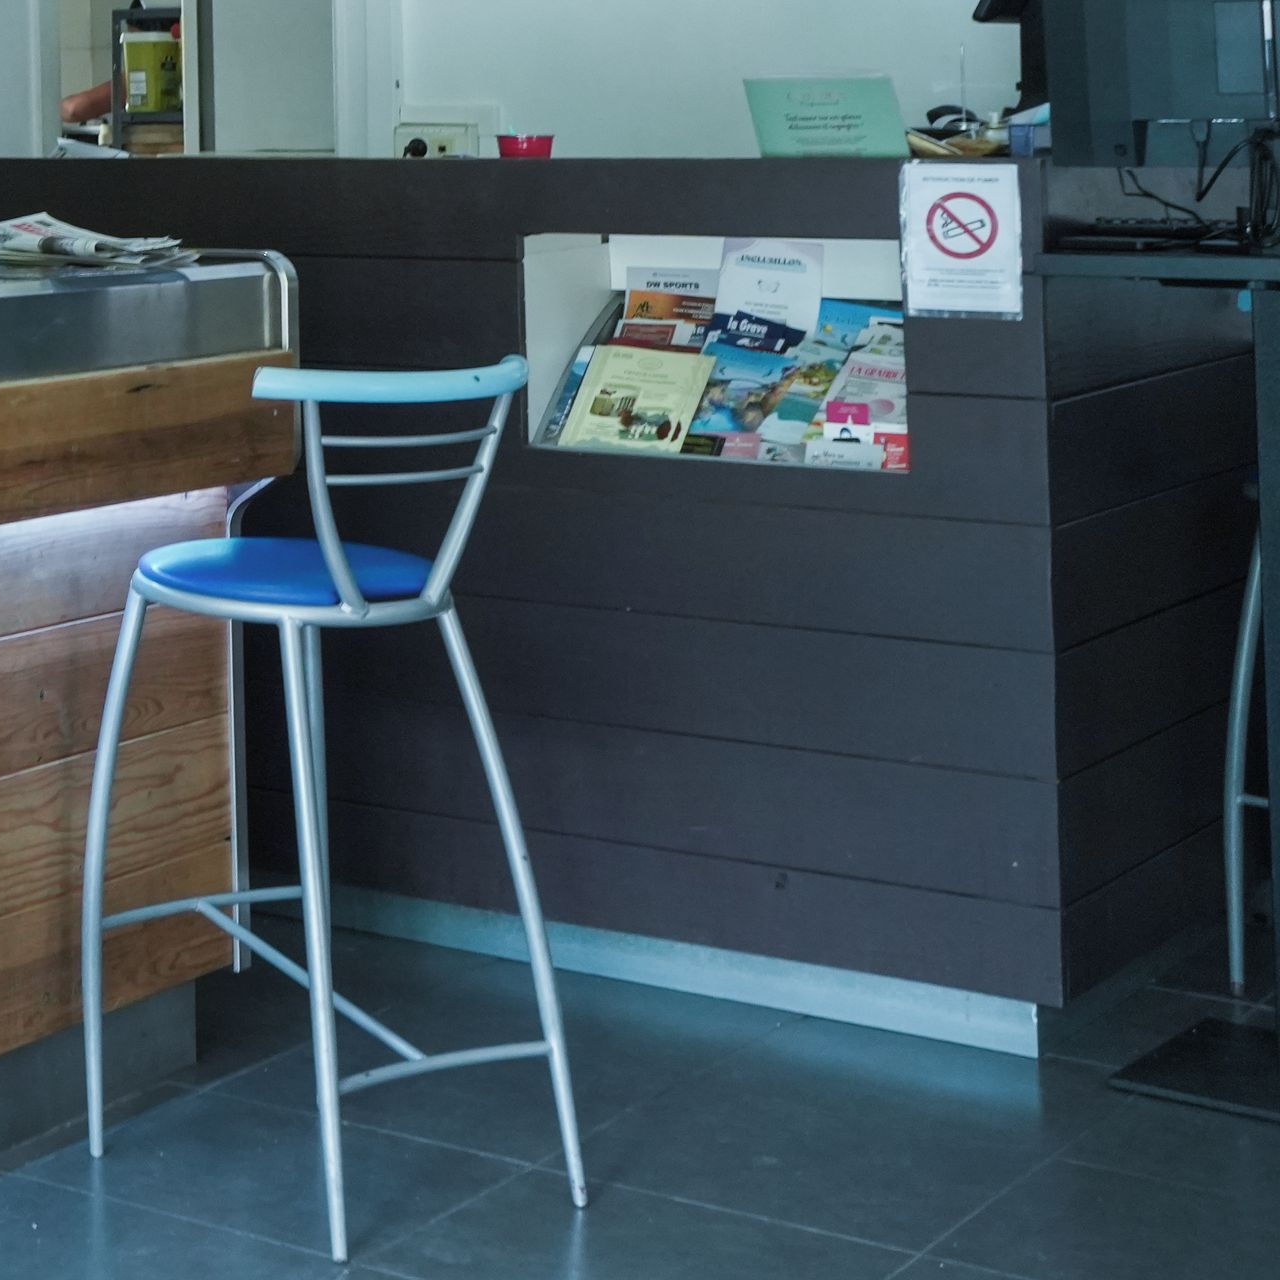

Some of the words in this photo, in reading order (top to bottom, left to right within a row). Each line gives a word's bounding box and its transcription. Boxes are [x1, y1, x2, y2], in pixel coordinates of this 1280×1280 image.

[646, 281, 660, 289] DW
[663, 281, 700, 290] SPORTS
[740, 319, 768, 339] Grave
